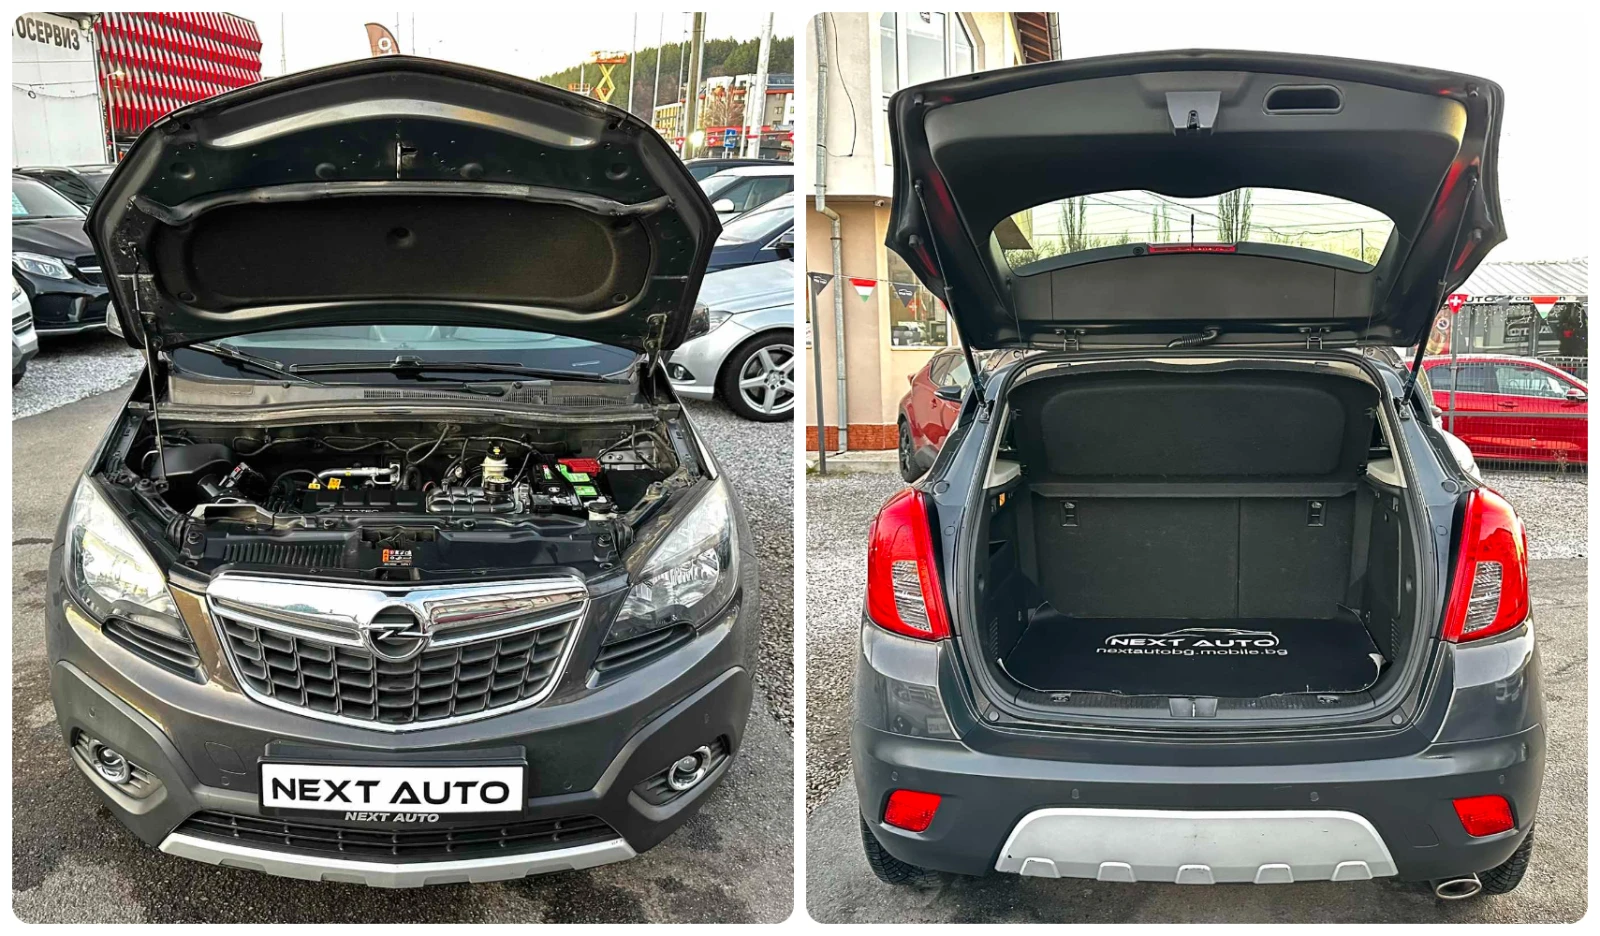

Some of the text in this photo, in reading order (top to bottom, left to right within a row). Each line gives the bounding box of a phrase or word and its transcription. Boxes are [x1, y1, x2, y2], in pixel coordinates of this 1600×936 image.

[12, 15, 80, 51] ОСЕРВИЗ
[1110, 638, 1276, 647] NEXT AUTO
[1096, 647, 1288, 656] nextautobg.mobile.bg
[272, 777, 510, 805] NEXT AUTO
[344, 811, 440, 823] NEXT AUTO
